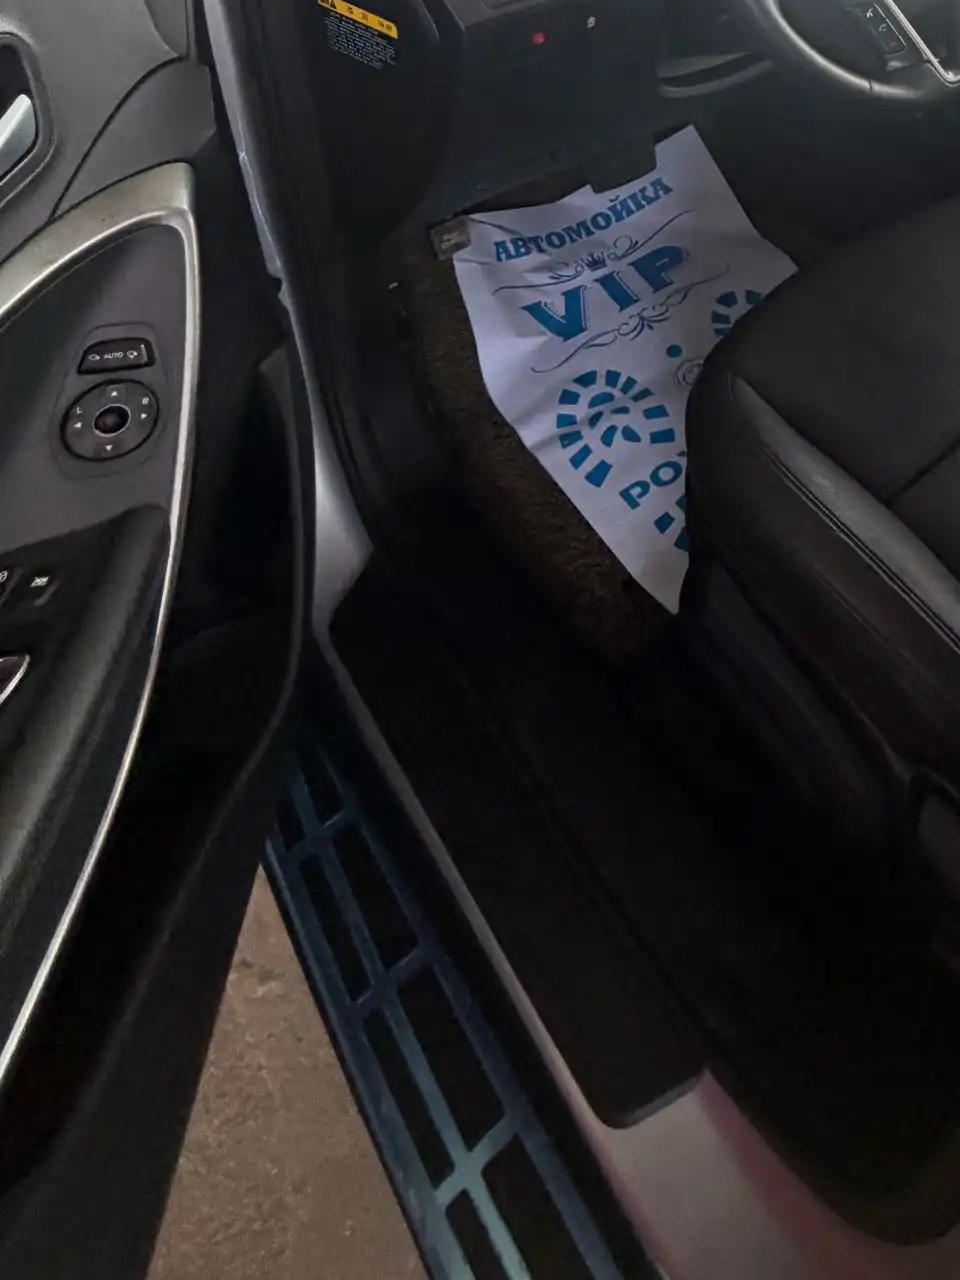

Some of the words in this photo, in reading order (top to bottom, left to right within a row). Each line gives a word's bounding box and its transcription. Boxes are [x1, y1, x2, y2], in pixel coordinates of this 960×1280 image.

[494, 177, 673, 262] АВТОМОЙКА
[520, 245, 690, 343] VIP
[103, 351, 124, 359] AUTO
[141, 396, 149, 405] R
[76, 406, 82, 414] L
